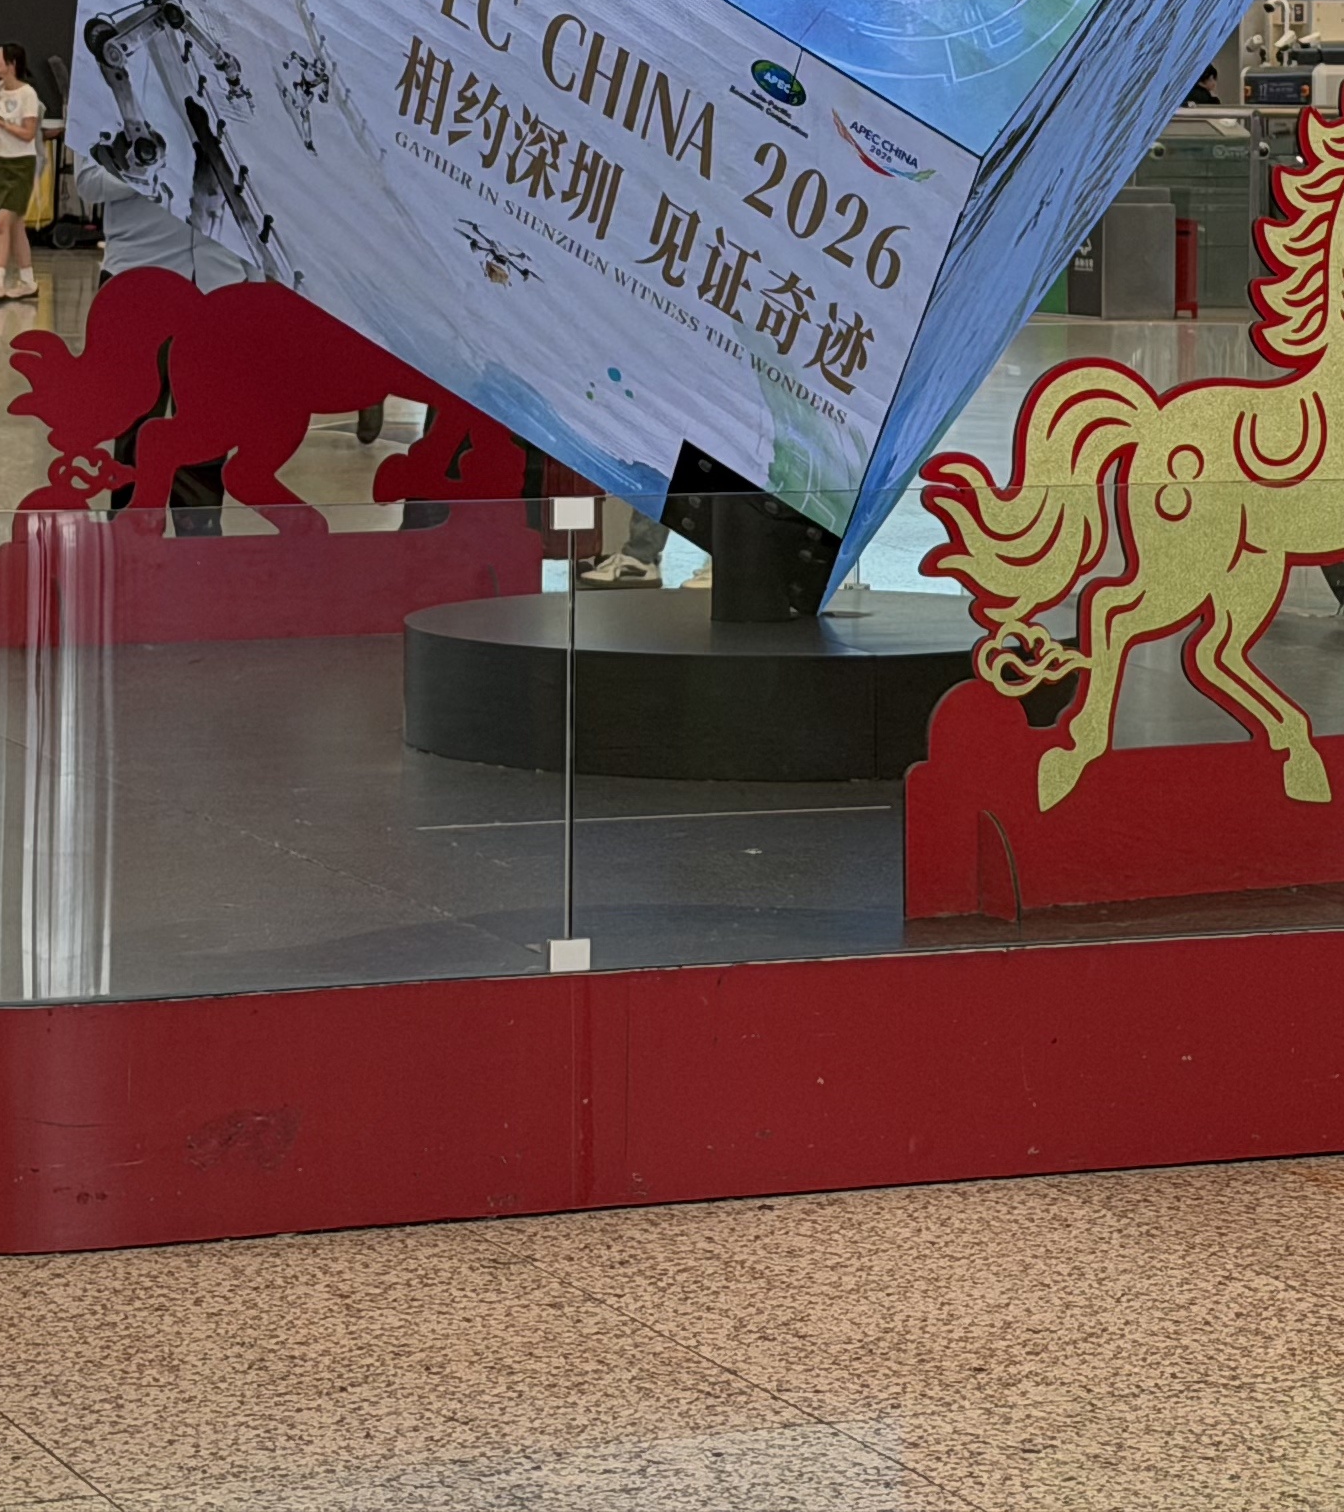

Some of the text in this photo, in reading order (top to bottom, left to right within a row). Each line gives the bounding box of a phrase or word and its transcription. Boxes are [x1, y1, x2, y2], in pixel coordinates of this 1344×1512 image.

[394, 34, 875, 396] 相约深圳 见证奇迹
[395, 131, 848, 426] GATHER IN SHENZHEN WITNESS THE WONDERS
[540, 13, 716, 181] CHINA
[742, 141, 912, 290] 2026
[849, 120, 919, 170] APEC CHINA
[868, 144, 893, 164] 2026
